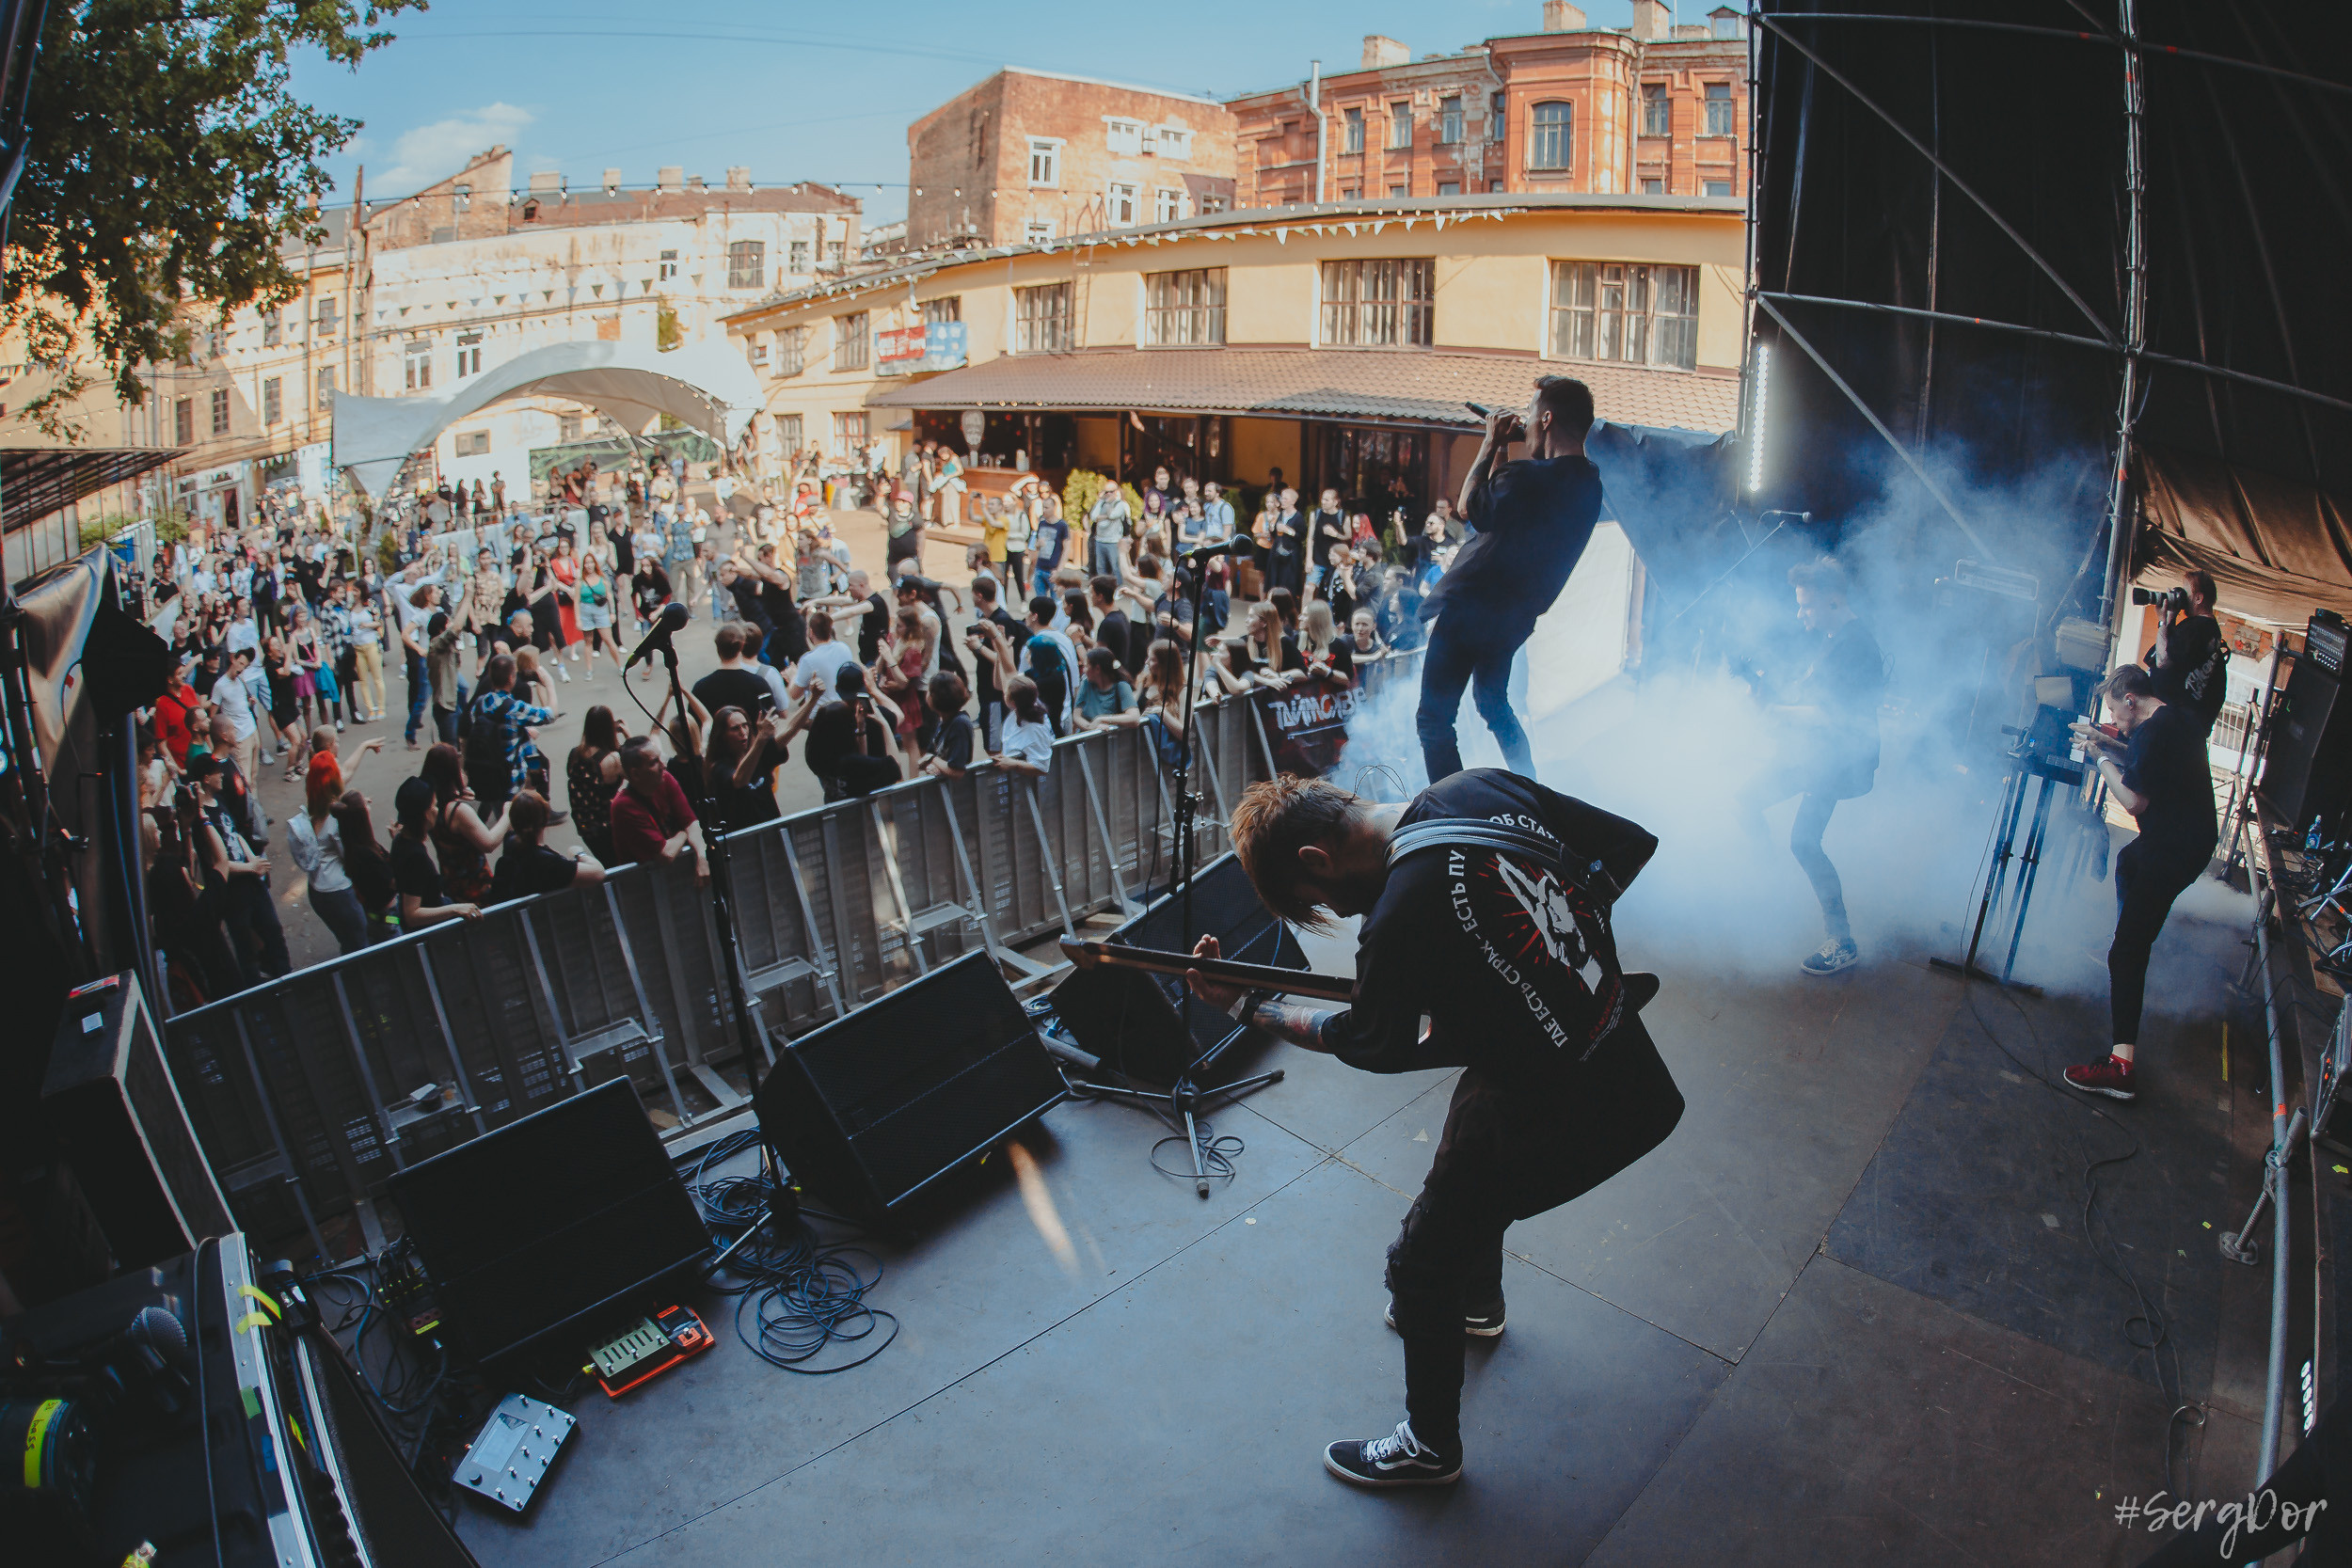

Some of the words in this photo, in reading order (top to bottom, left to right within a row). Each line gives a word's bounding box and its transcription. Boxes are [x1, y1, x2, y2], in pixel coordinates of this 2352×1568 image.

[1485, 813, 1516, 827] ОБ
[1518, 815, 1560, 843] СТАТ
[1448, 847, 1468, 877] ПУ
[1451, 882, 1478, 933] ЕСТЬ
[1480, 940, 1520, 985] СТРАХ
[1520, 982, 1550, 1022] ЕСТЬ
[1543, 1018, 1568, 1048] ГДЕ
